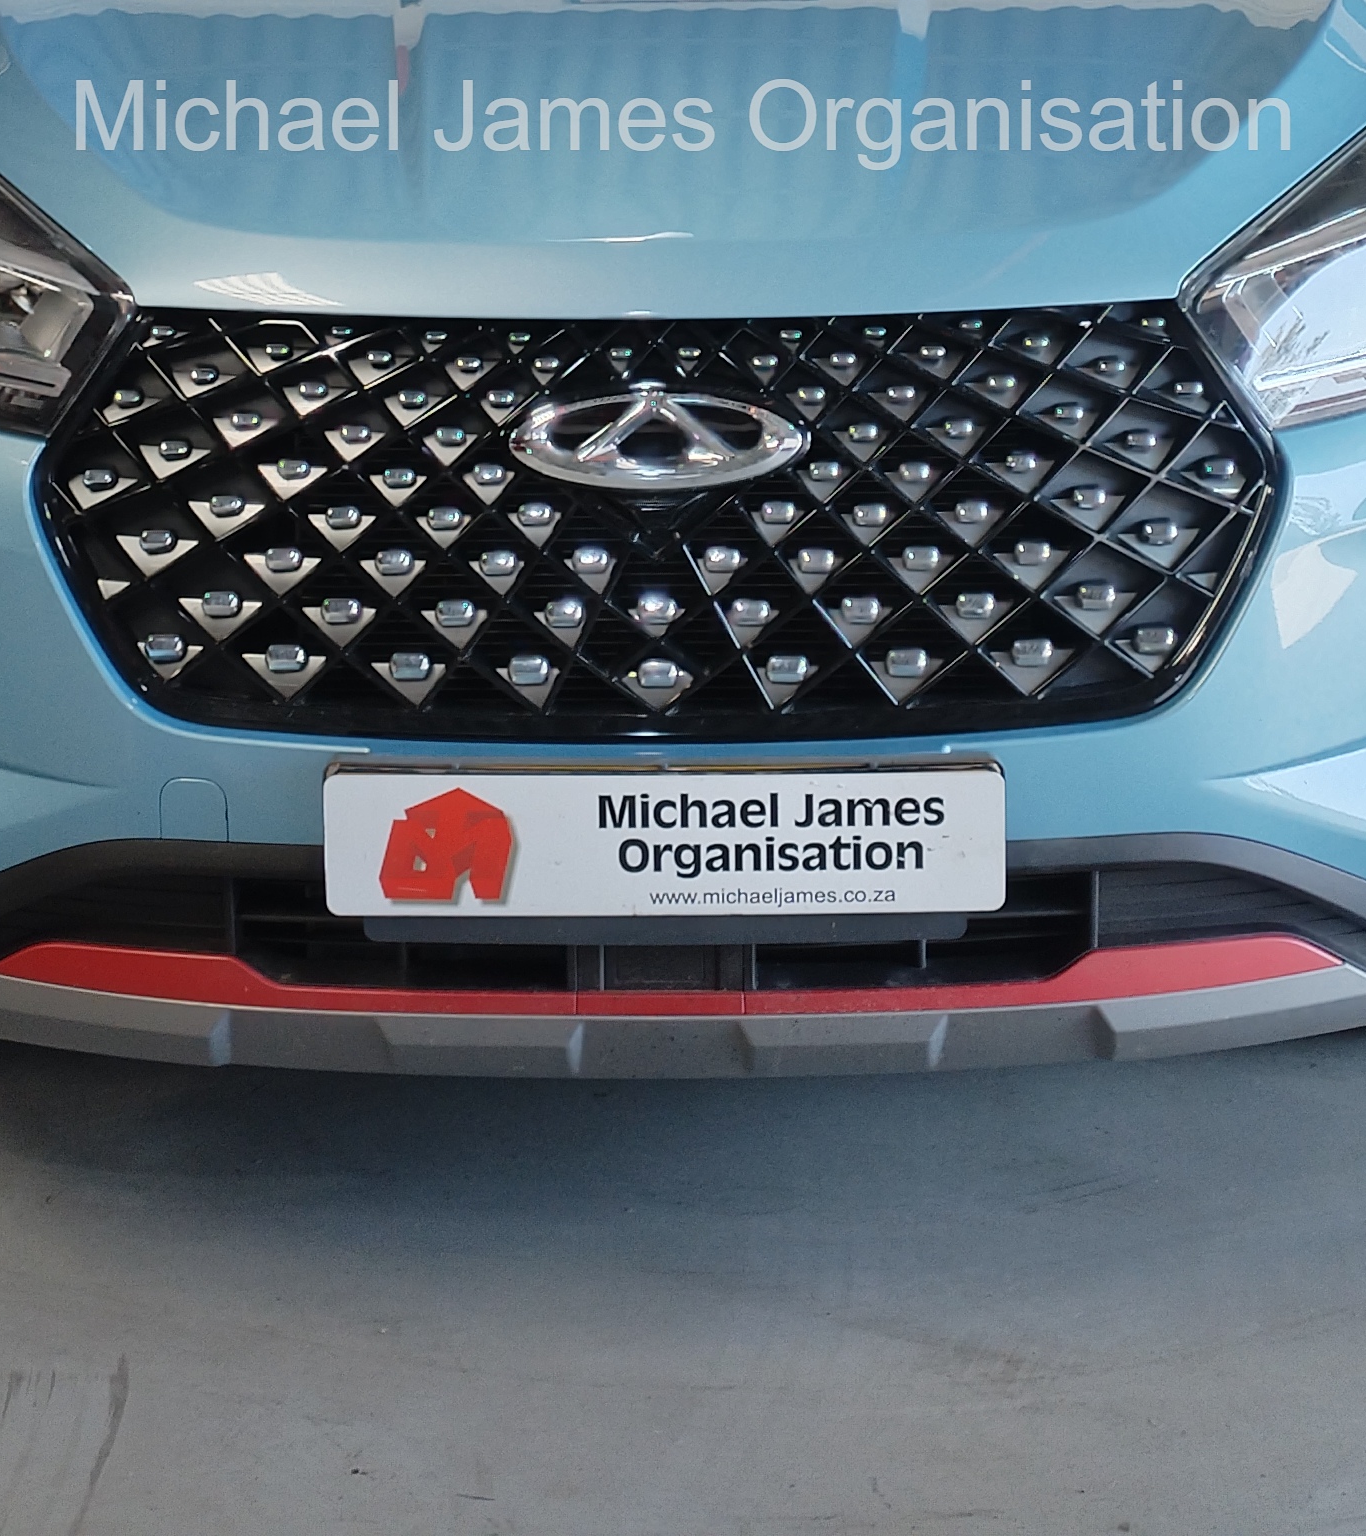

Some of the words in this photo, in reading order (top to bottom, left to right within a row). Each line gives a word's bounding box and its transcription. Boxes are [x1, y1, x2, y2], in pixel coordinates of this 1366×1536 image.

[598, 792, 779, 829] Michael
[794, 793, 945, 828] James
[618, 835, 924, 879] Organisation
[649, 887, 897, 906] www.michaeljames.co.za
